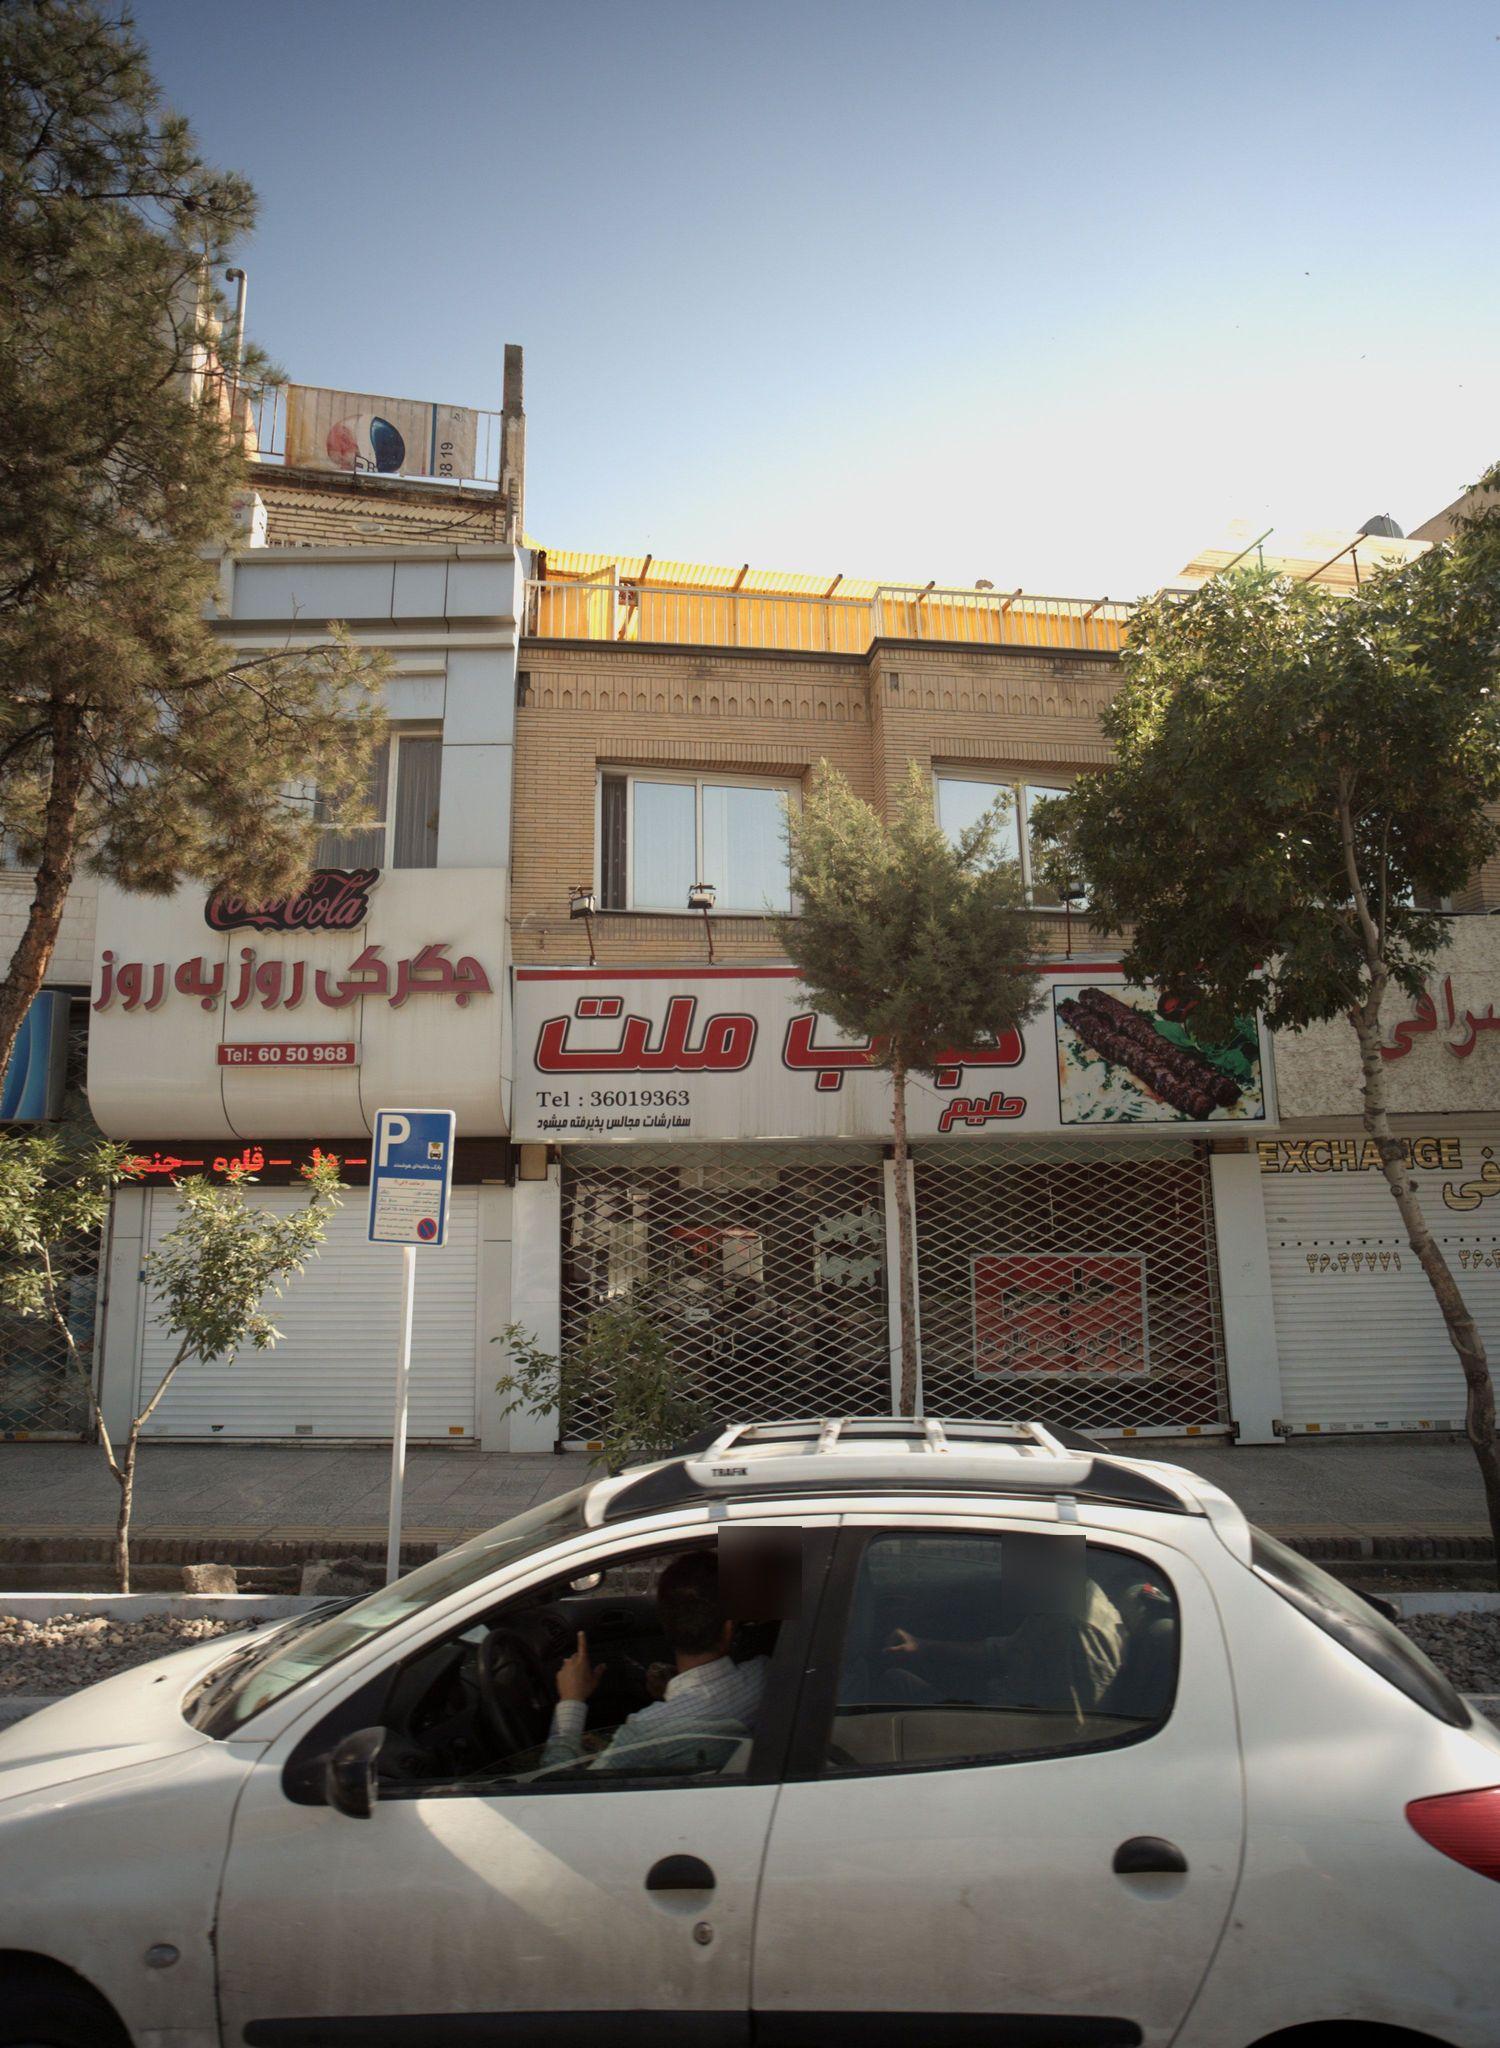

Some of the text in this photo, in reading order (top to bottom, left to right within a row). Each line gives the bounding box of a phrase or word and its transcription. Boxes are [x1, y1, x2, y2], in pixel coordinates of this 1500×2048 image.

[440, 442, 453, 458] 19
[92, 950, 167, 1011] روز
[174, 957, 225, 1011] به
[231, 947, 306, 1011] روز
[534, 994, 758, 1074] ملت
[224, 1047, 347, 1062] Tel: 60 50 968
[590, 1090, 690, 1107] 36019363
[938, 1092, 1027, 1132] حلیم
[570, 1115, 604, 1133] پذیرفته
[606, 1116, 640, 1130] مجالس
[643, 1113, 691, 1129] سفارشات
[379, 1114, 411, 1167] P
